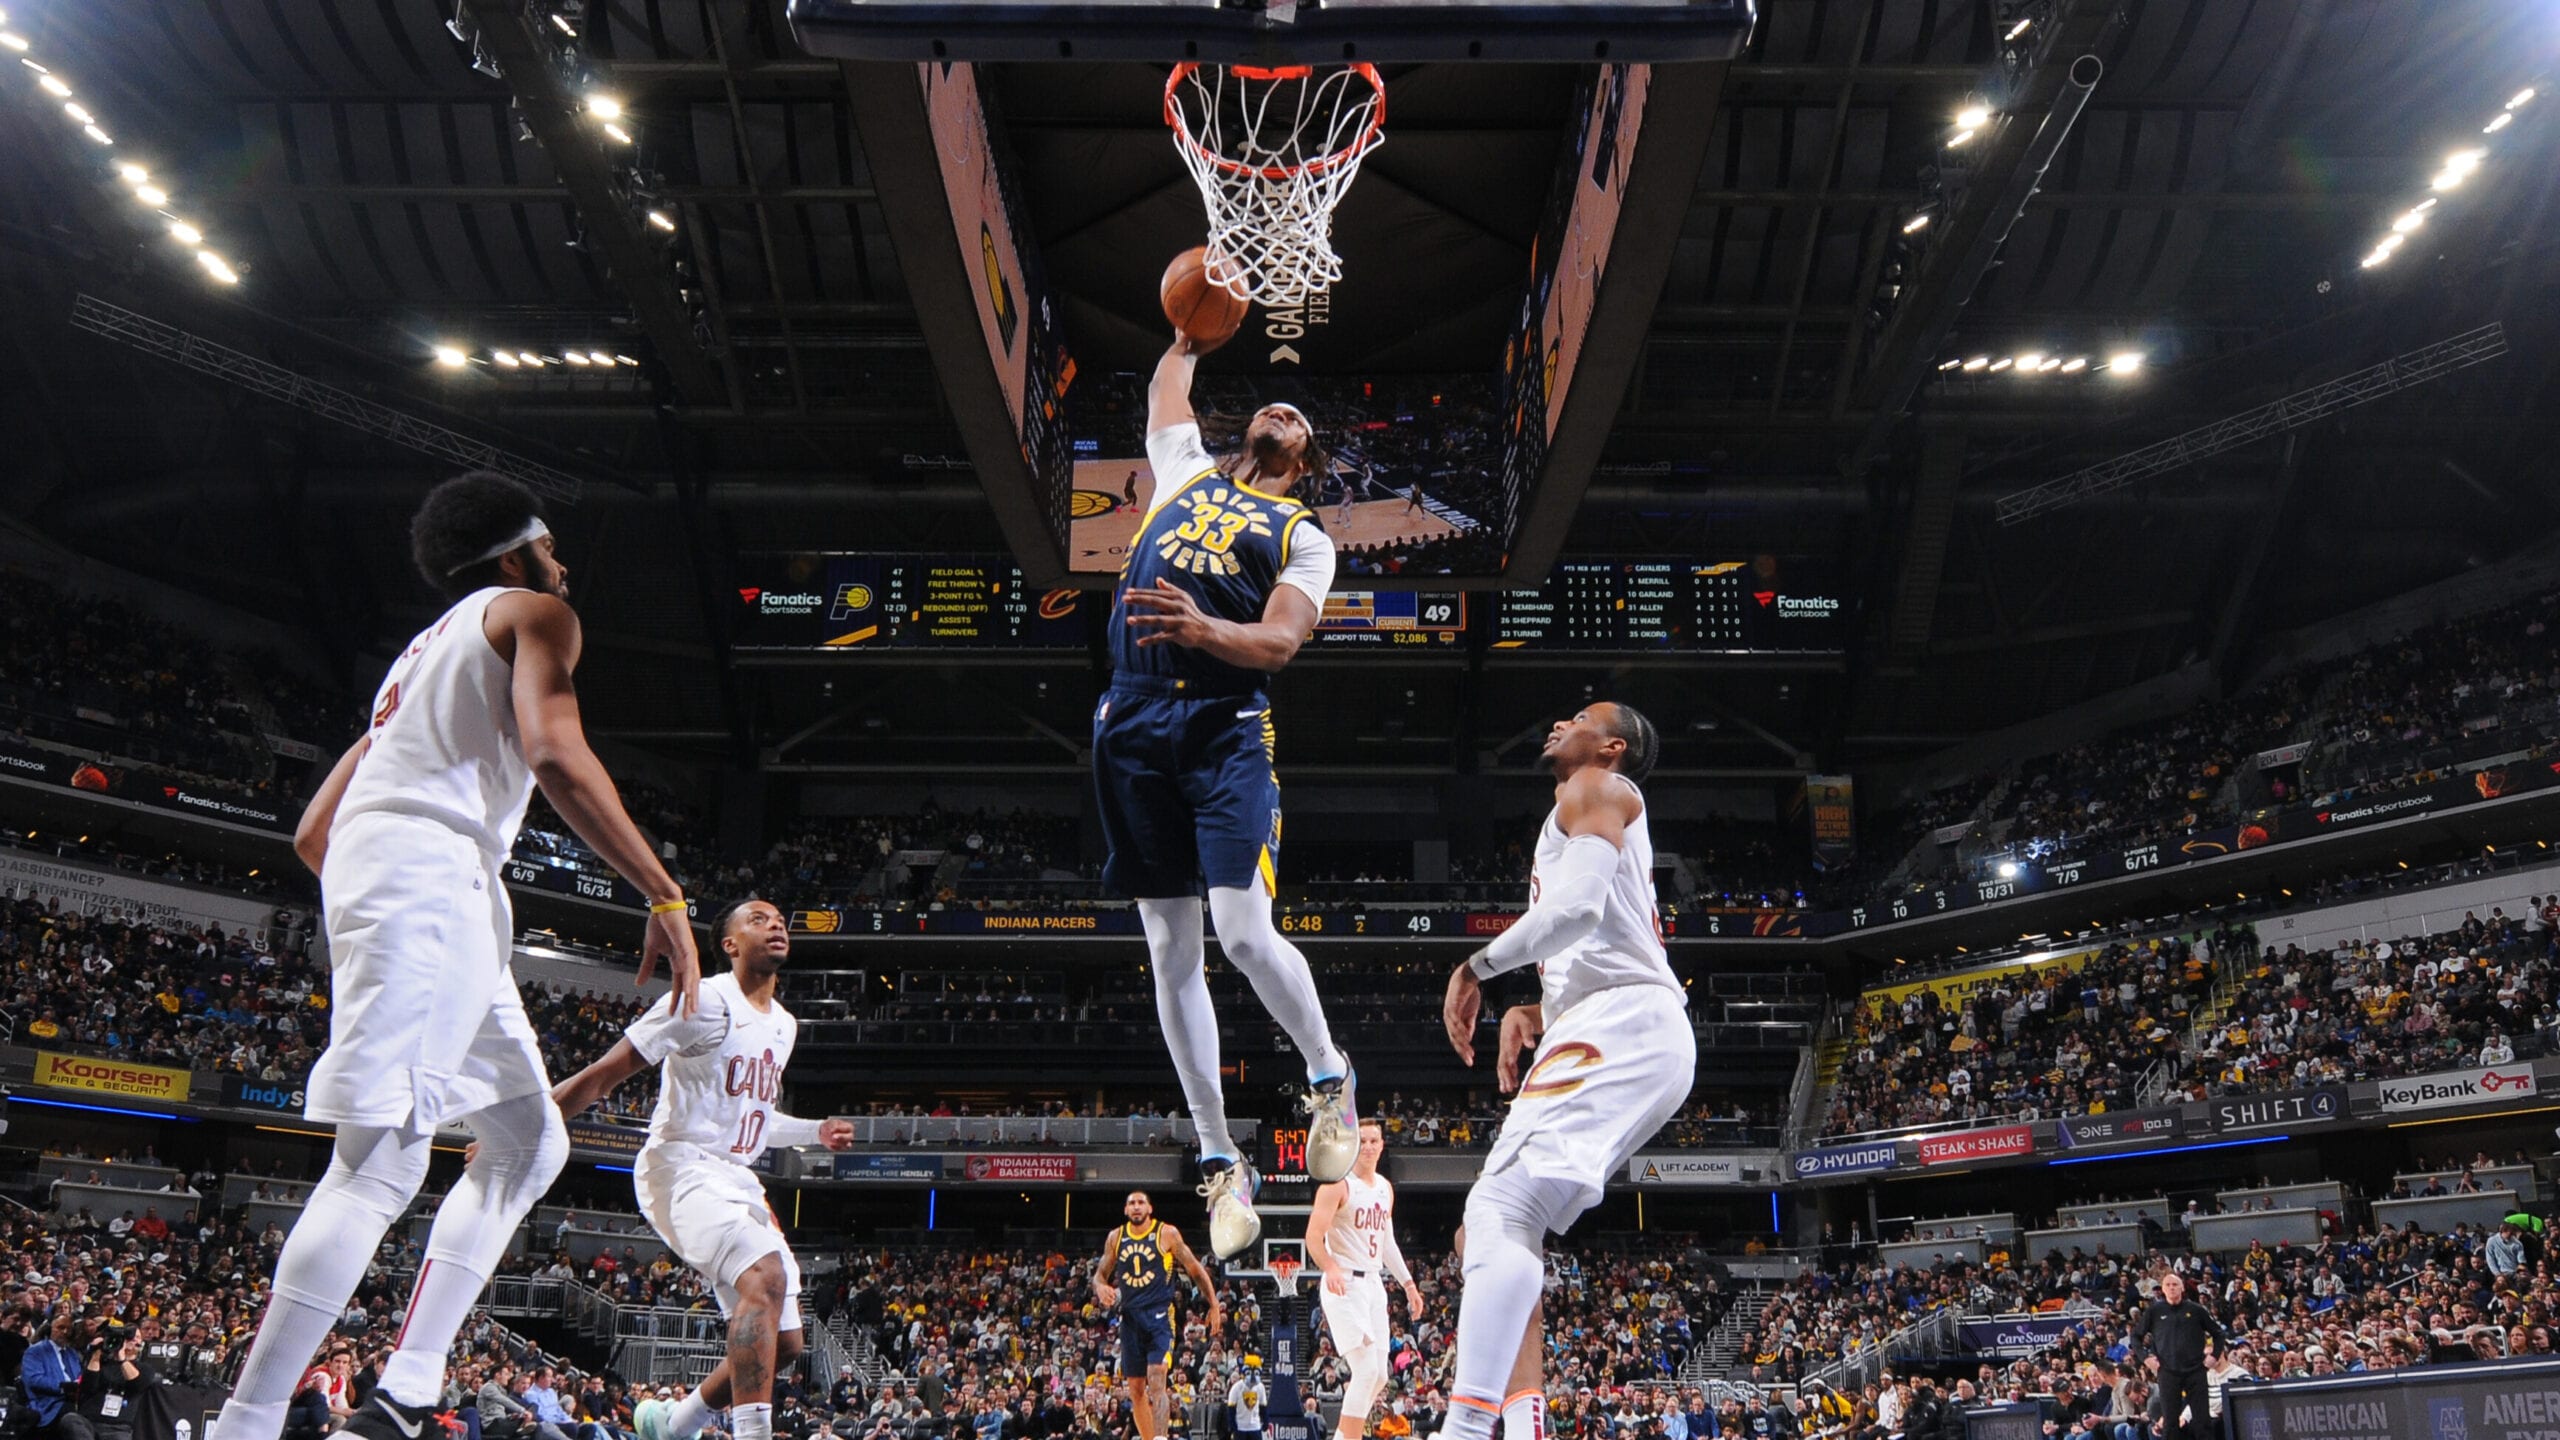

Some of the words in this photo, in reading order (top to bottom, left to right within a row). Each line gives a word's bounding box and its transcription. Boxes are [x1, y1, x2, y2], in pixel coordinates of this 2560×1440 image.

[1177, 487, 1273, 538] INDIANA
[1176, 502, 1249, 554] 33
[1155, 529, 1241, 575] PACERS
[892, 568, 903, 576] 47
[979, 581, 986, 589] %
[1011, 580, 1022, 588] 77
[761, 592, 823, 606] Fanatics
[1010, 593, 1021, 601] 42
[1777, 595, 1839, 609] Fanatics
[761, 605, 814, 615] Sportsbook
[884, 604, 894, 612] 12
[967, 604, 989, 613] (OFF)
[1004, 604, 1014, 612] 17
[1015, 604, 1027, 613] (3)
[1424, 605, 1451, 621] 49
[1778, 608, 1830, 618] Sportsbook
[1378, 619, 1413, 627] CURRENT
[931, 629, 978, 637] TURNOVERS
[1322, 634, 1358, 642] JACKPOT
[1359, 634, 1382, 642] TOTAL
[1393, 633, 1428, 645] $2,086
[1513, 630, 1543, 638] TURNER
[177, 792, 221, 810] Fanatics
[221, 801, 278, 822] Sportsbook
[2331, 807, 2373, 823] Fanatics
[2374, 794, 2434, 814] Sportsbook
[2125, 854, 2159, 871] 6/14
[9, 861, 105, 888] ASSISTANCE?
[511, 868, 535, 883] 6/9
[2055, 869, 2080, 885] 7/9
[576, 880, 612, 899] 16/34
[1977, 882, 2015, 901] 18/31
[1937, 897, 1946, 909] 3
[1892, 905, 1907, 919] 10
[873, 920, 882, 931] 5
[919, 920, 926, 931] 1
[985, 917, 1040, 929] INDIANA
[1043, 917, 1096, 929] PACERS
[1282, 915, 1323, 932] 6:48
[1356, 921, 1365, 933] 2
[1408, 916, 1431, 933] 49
[1666, 921, 1677, 934] 3
[1852, 914, 1866, 927] 17
[1711, 922, 1719, 934] 6
[51, 1057, 171, 1088] Koorsen
[725, 1054, 783, 1105] CAVS
[49, 1074, 78, 1086] FIRE
[85, 1079, 96, 1087] &
[103, 1082, 170, 1098] SECURITY
[2382, 1079, 2478, 1106] KeyBank
[2221, 1098, 2305, 1127] SHIFT
[2317, 1096, 2330, 1113] 4
[730, 1109, 766, 1154] 10
[2143, 1118, 2173, 1132] 100.9
[585, 1138, 609, 1147] PACERS
[610, 1141, 627, 1149] TEAM
[1274, 1130, 1307, 1145] 6:47
[1922, 1139, 1966, 1158] STEAK
[1979, 1134, 2026, 1151] SHAKE
[993, 1158, 1035, 1167] INDIANA
[1037, 1158, 1072, 1167] FEVER
[1278, 1145, 1304, 1171] 14
[1824, 1148, 1896, 1170] HYUNDAI
[899, 1170, 935, 1178] HENSLEY.
[999, 1168, 1066, 1178] BASKETBALL
[1661, 1163, 1682, 1172] LIFT
[1683, 1163, 1730, 1172] ACADEMY
[1275, 1175, 1310, 1183] TISSOT
[1354, 1204, 1388, 1232] CAVS
[1119, 1243, 1156, 1263] INDIANA
[1369, 1234, 1378, 1258] 5
[1133, 1255, 1140, 1276] 1
[1122, 1270, 1156, 1288] PACERS
[1278, 1340, 1290, 1351] GET
[1278, 1352, 1290, 1362] THE
[2483, 1388, 2560, 1426] AMER
[2283, 1401, 2388, 1433] AMERICAN
